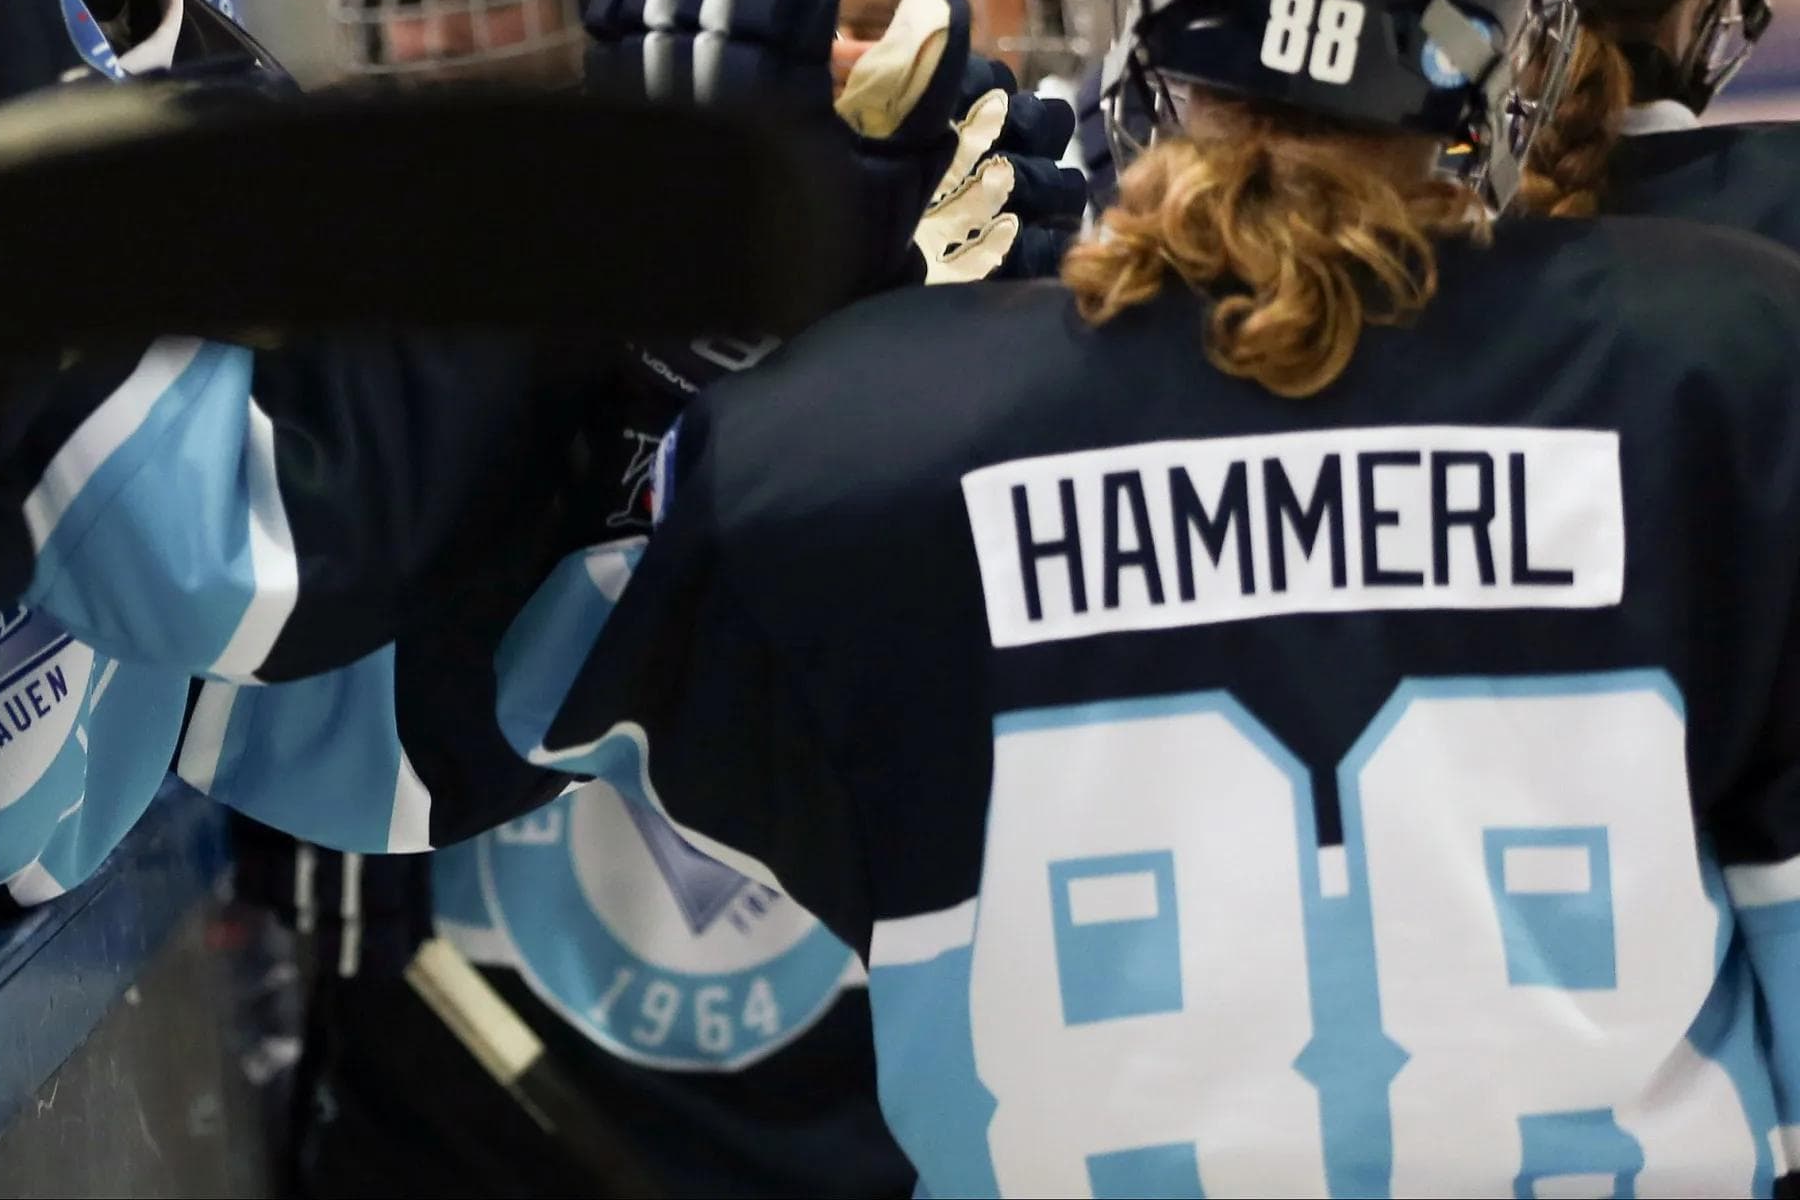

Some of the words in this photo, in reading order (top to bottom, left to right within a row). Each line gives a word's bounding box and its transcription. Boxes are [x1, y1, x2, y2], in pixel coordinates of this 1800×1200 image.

[1011, 450, 1575, 622] HAMMERL
[585, 966, 782, 1054] 1964
[968, 668, 1762, 1200] 88
